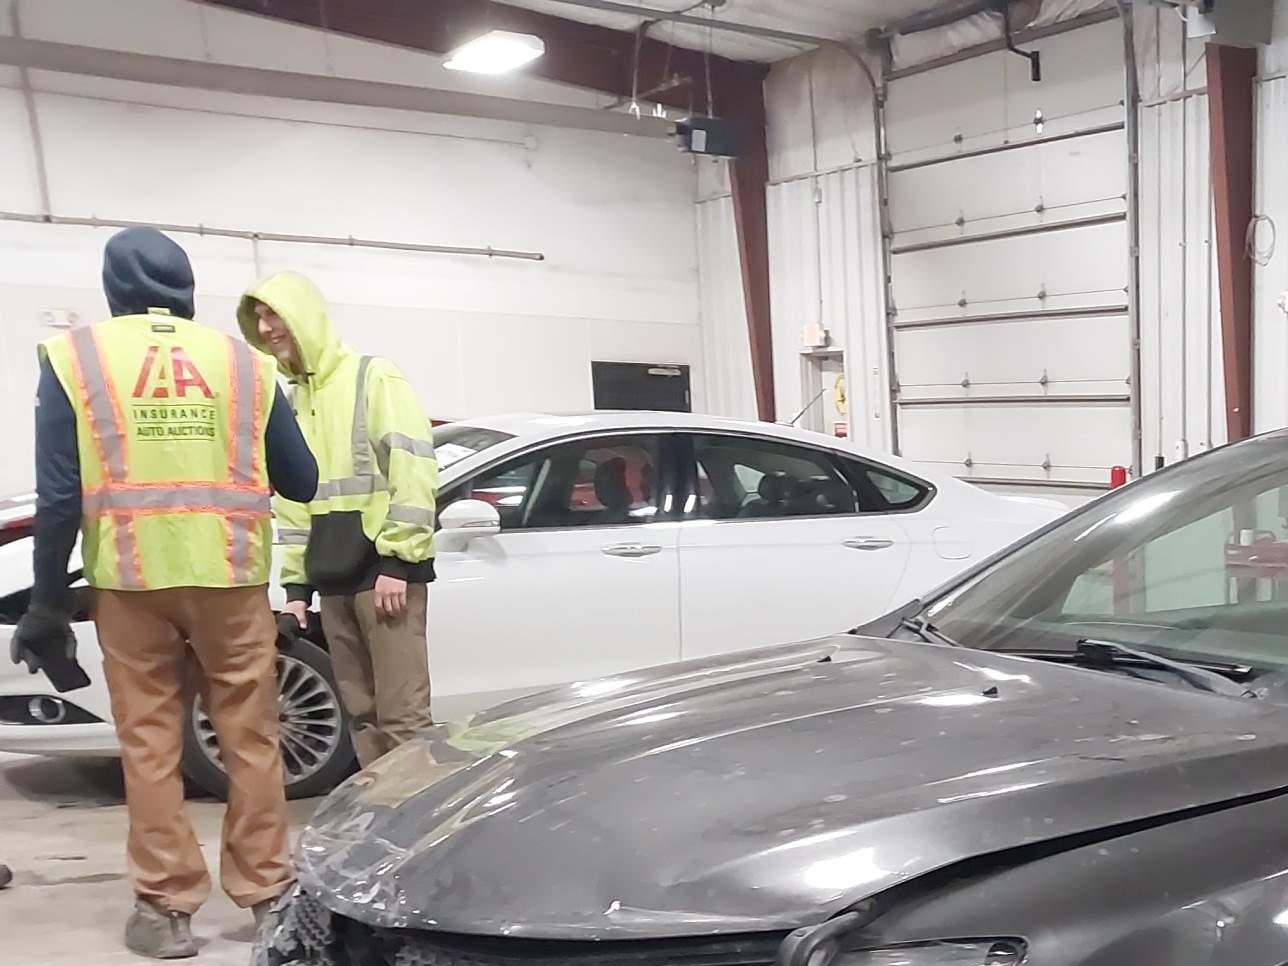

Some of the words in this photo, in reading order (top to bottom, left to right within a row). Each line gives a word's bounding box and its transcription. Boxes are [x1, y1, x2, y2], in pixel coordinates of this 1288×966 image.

[133, 408, 216, 420] INSURANCE
[136, 426, 164, 437] AUTO
[167, 425, 216, 437] AUCTIONS
